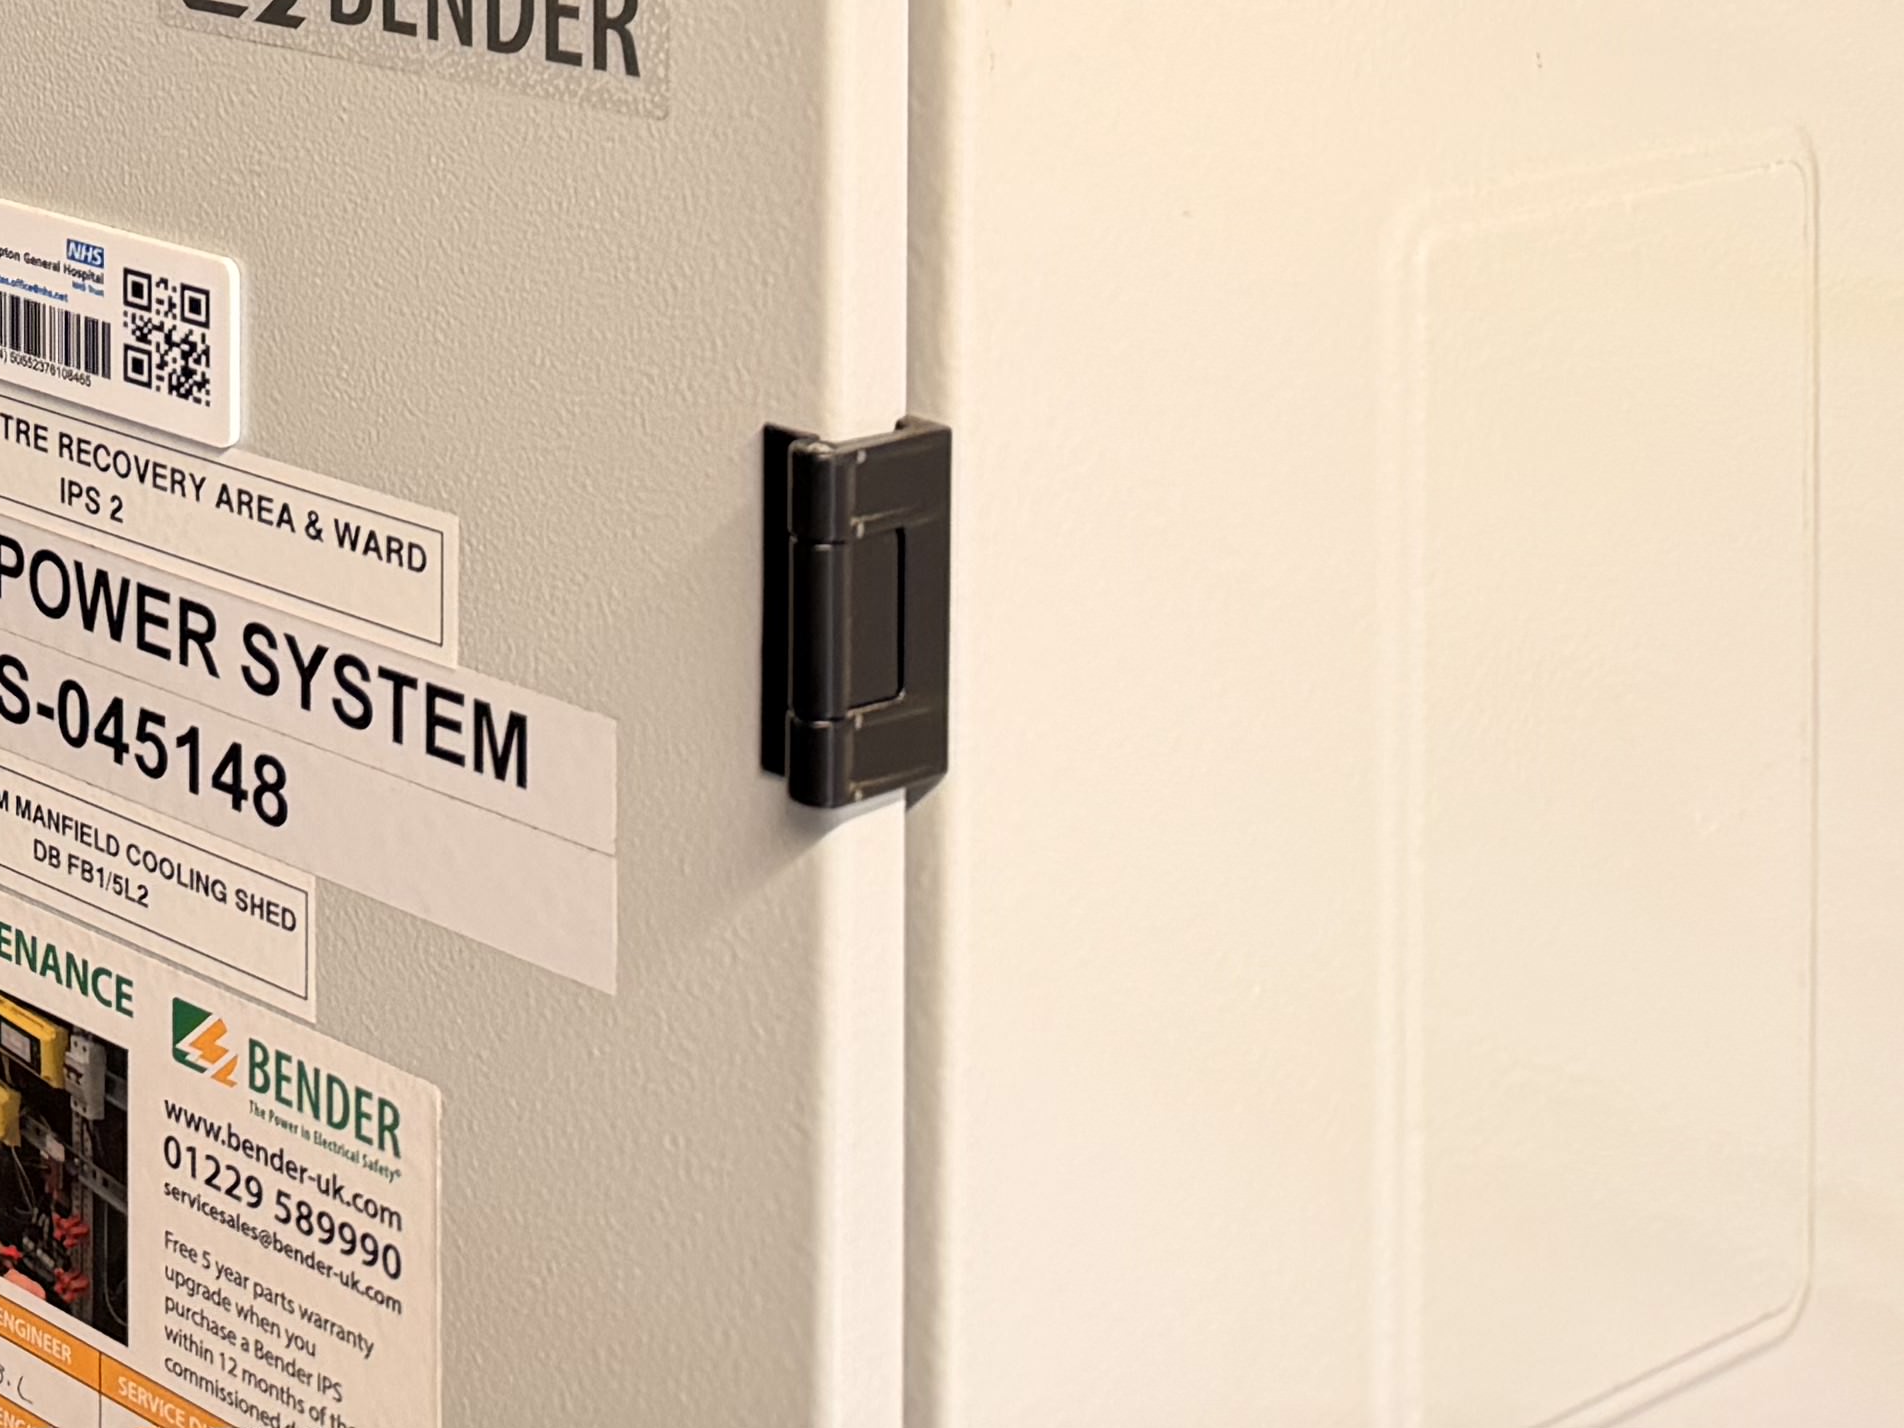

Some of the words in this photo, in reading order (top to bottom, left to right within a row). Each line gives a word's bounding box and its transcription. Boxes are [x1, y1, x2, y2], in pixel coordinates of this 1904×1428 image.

[23, 252, 61, 273] General
[63, 261, 104, 284] Hospital
[68, 240, 104, 267] NHS
[57, 431, 207, 503] RECOVERY
[215, 483, 296, 534] AREA
[304, 511, 323, 541] &
[334, 519, 427, 574] WARD
[59, 477, 101, 516] IPS
[109, 496, 124, 524] 2
[240, 621, 529, 791] SYSTEM
[15, 794, 120, 857] MANFIELD
[126, 843, 228, 904] COOLING
[235, 887, 298, 933] SHED
[33, 838, 61, 869] DB
[67, 852, 150, 908] FB1/5L2
[249, 1037, 402, 1159] BENDER
[249, 1099, 265, 1118] The
[268, 1109, 298, 1136] Power
[313, 1133, 361, 1165] Electrical
[163, 1098, 402, 1232] www.bender-uk.com
[163, 1136, 263, 1209] 01229
[274, 1187, 402, 1281] 589990
[163, 1180, 403, 1315] servicesales@bender-uk.com
[164, 1230, 198, 1264] Free
[202, 1251, 211, 1271] 5
[215, 1259, 249, 1291] year
[253, 1280, 295, 1315] parts
[298, 1304, 375, 1360] warranty
[164, 1265, 231, 1312] upgrade
[235, 1299, 281, 1337] when
[284, 1327, 317, 1358] you
[164, 1296, 237, 1346] purchase
[241, 1336, 250, 1353] a
[254, 1339, 313, 1387] Bender
[317, 1371, 343, 1403] IPS
[118, 1376, 185, 1426] SERVICE
[164, 1324, 214, 1365] within
[220, 1350, 239, 1378] 12
[242, 1370, 305, 1415] months
[308, 1405, 328, 1426] of
[330, 1413, 356, 1428] th
[164, 1356, 281, 1428] commissioned
